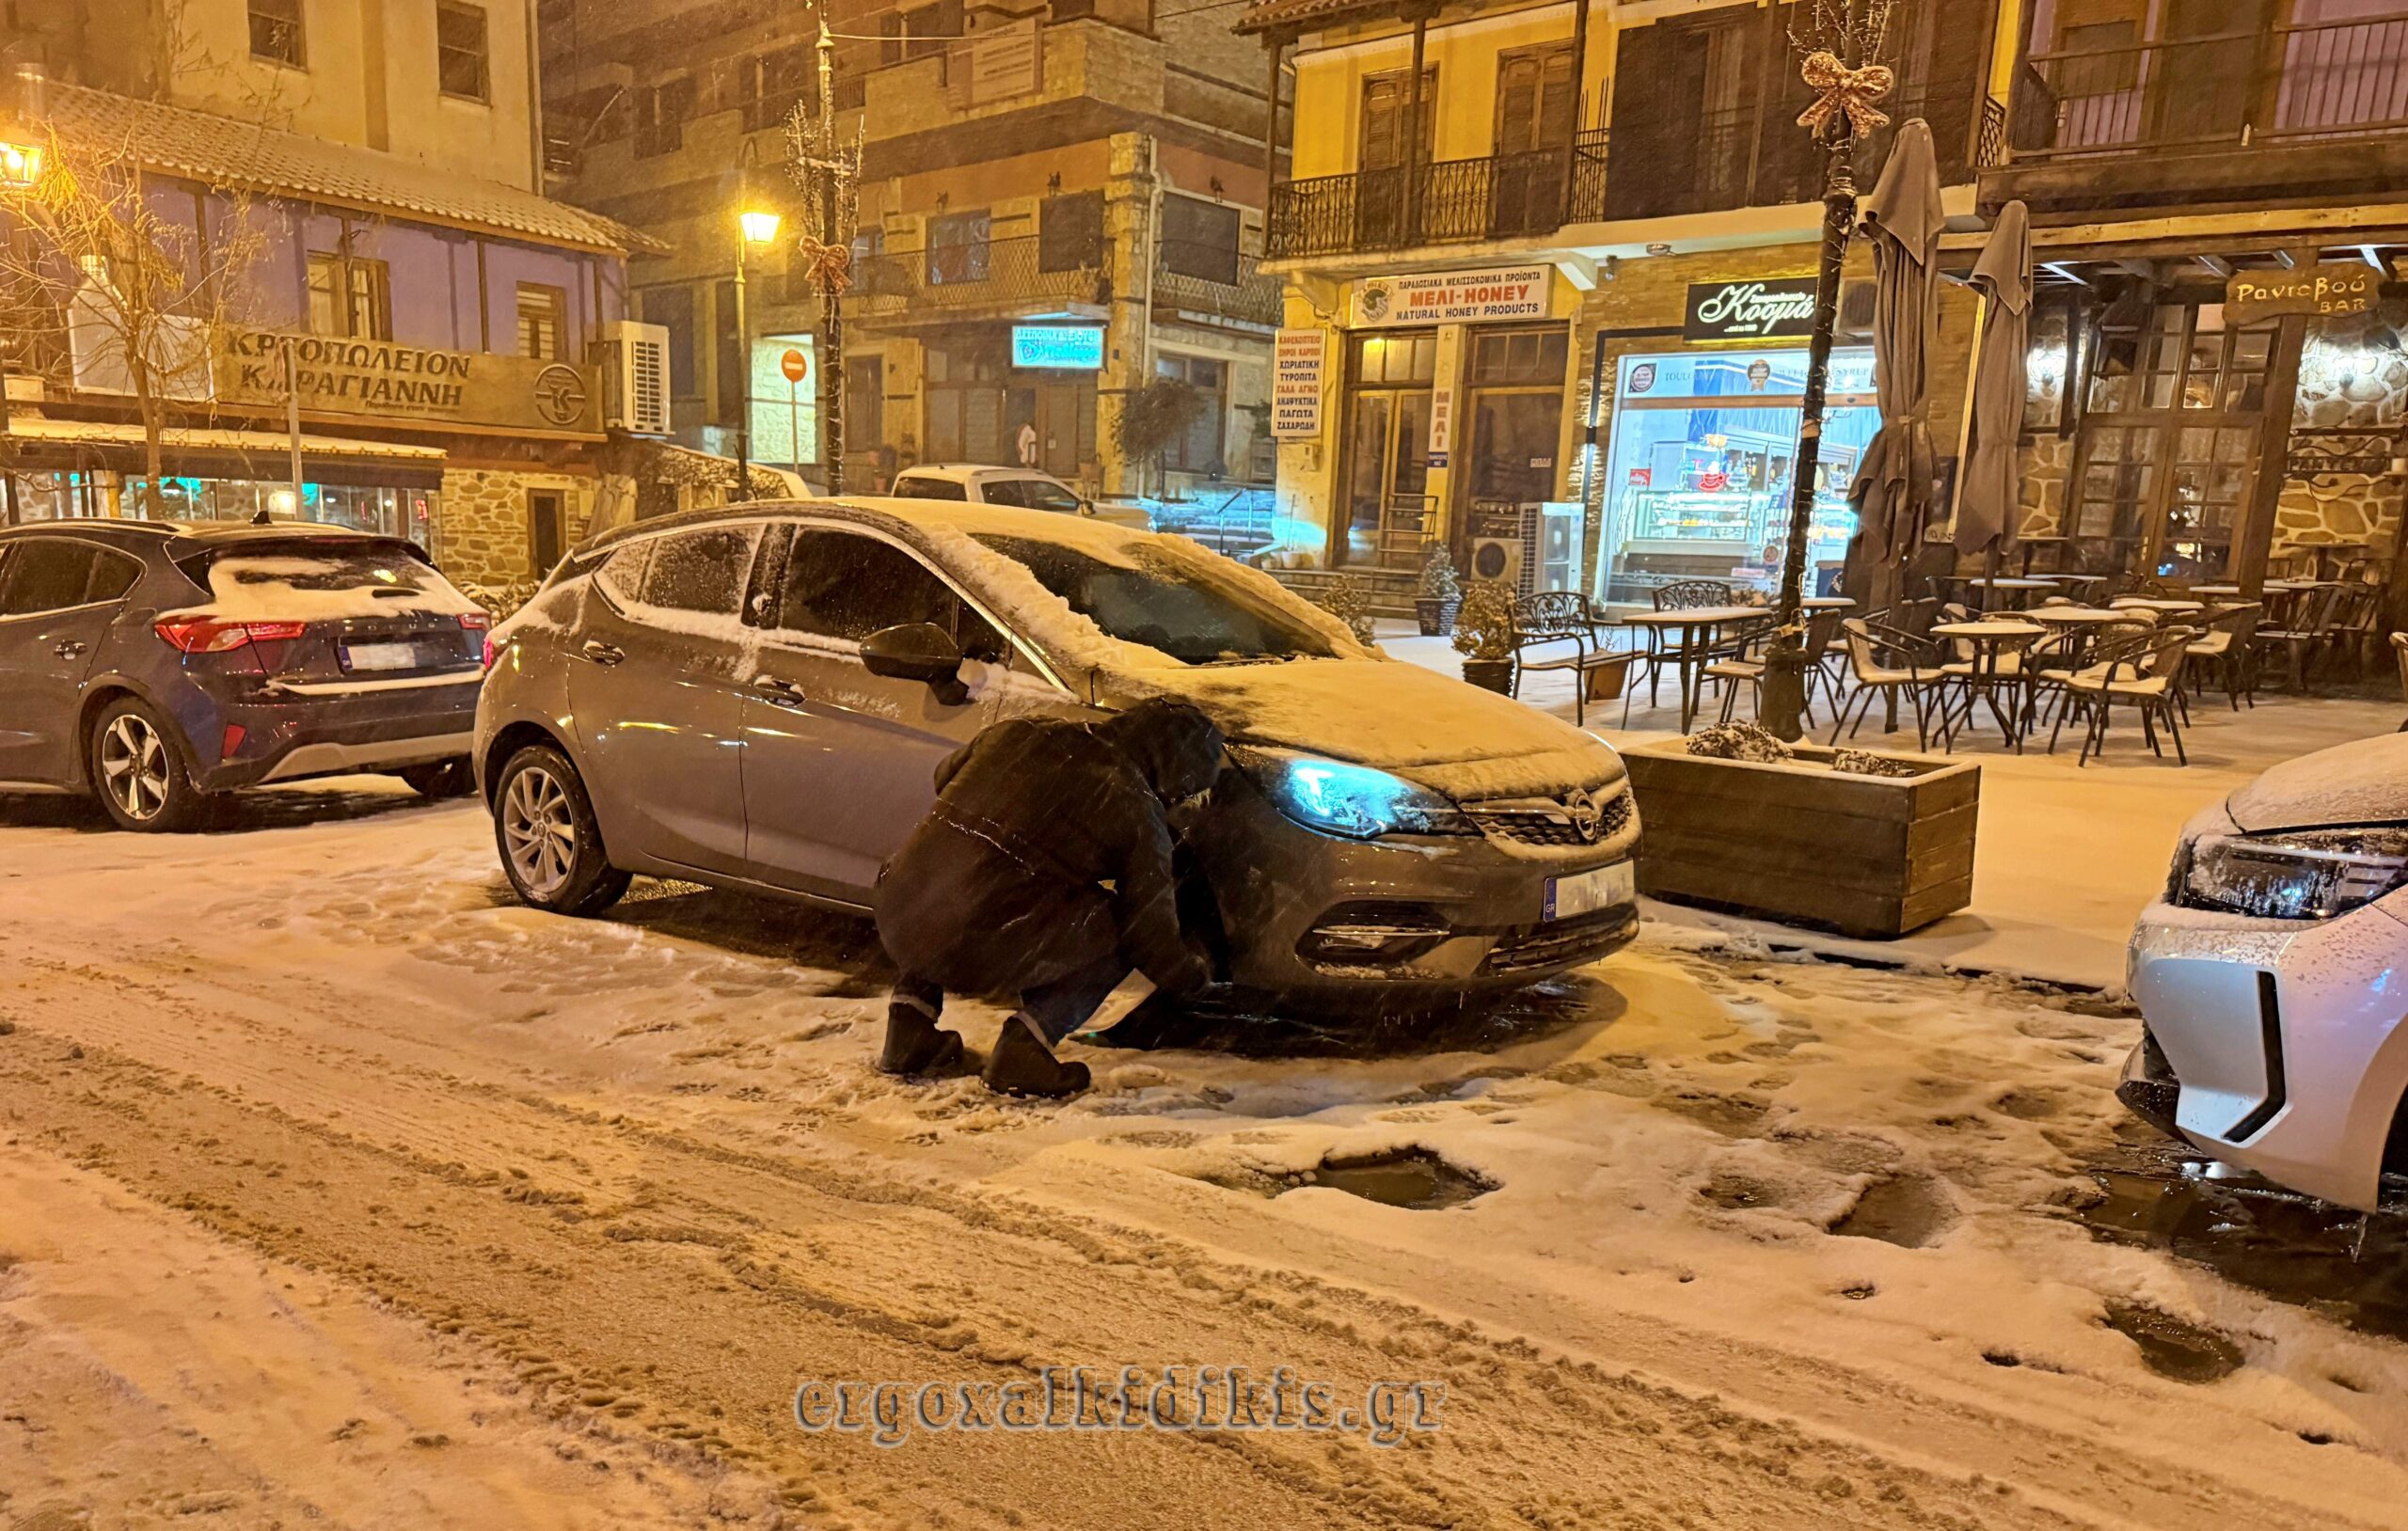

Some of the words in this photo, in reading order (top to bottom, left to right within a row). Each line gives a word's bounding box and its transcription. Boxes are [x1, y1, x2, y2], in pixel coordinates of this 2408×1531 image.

[1398, 278, 1442, 291] ΠΑΡΑΔΟΣΙΑΚΑ
[1410, 284, 1530, 308] ΜΕΛΙ-HONEY
[1698, 282, 1815, 335] Κοσμά
[2320, 298, 2367, 313] BAR
[1396, 308, 1440, 321] NATURAL
[1446, 306, 1479, 318] HONEY
[1483, 302, 1539, 315] PRODUCTS
[1279, 360, 1320, 370] ΧΩΡΙΑΤΙΚΗ
[1279, 372, 1317, 382] ΤΥΡΟΠΙΤΑ
[1276, 385, 1295, 394] ΓΑΛΑ
[1298, 385, 1319, 394] ΑΓΝΟ
[1276, 397, 1317, 405] ΑΝΑΨΥΚΤΙΚΑ
[1278, 409, 1313, 418] ΠΑΓΩΤΑ
[1434, 391, 1450, 447] ΜΕΛΙ
[1276, 421, 1315, 431] ΖΑΧΑΡΩΔΗ
[1545, 903, 1555, 913] GR
